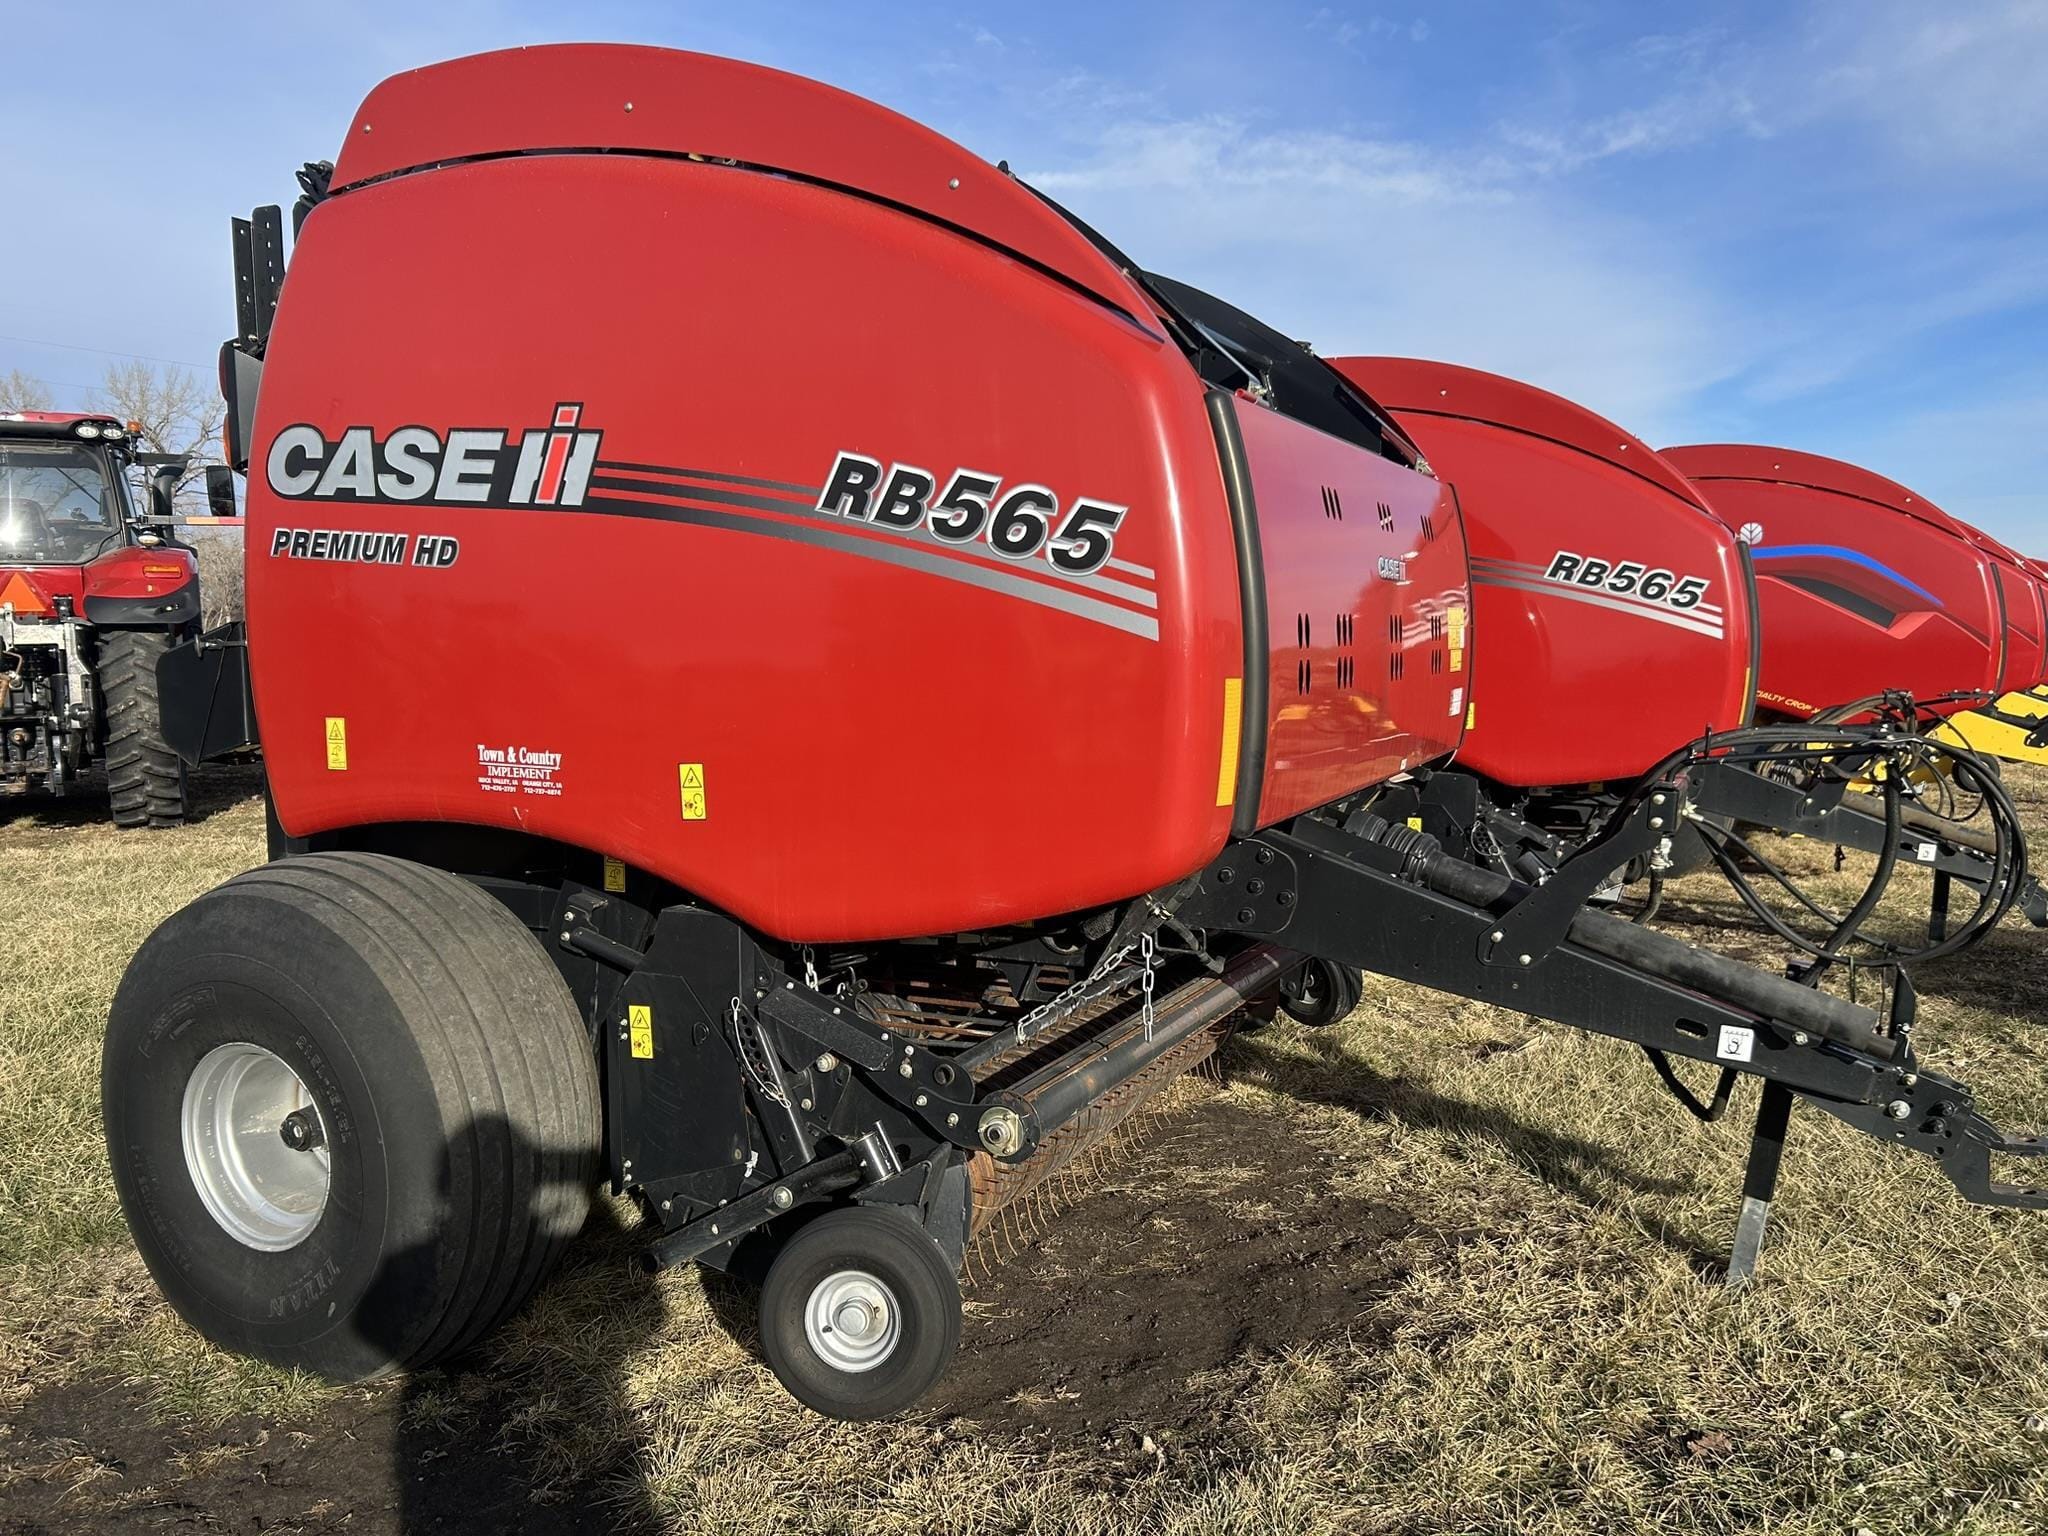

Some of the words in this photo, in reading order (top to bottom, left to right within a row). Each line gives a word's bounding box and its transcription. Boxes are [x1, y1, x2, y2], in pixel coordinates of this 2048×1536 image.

[266, 424, 506, 501] CASE
[814, 450, 1130, 577] RB565
[271, 528, 408, 565] PREMIUM
[411, 535, 459, 568] HD
[1544, 550, 1711, 610] RB565
[477, 744, 505, 762] Town
[507, 746, 517, 763] &
[519, 746, 562, 770] Country
[487, 766, 552, 780] IMPLEMENT
